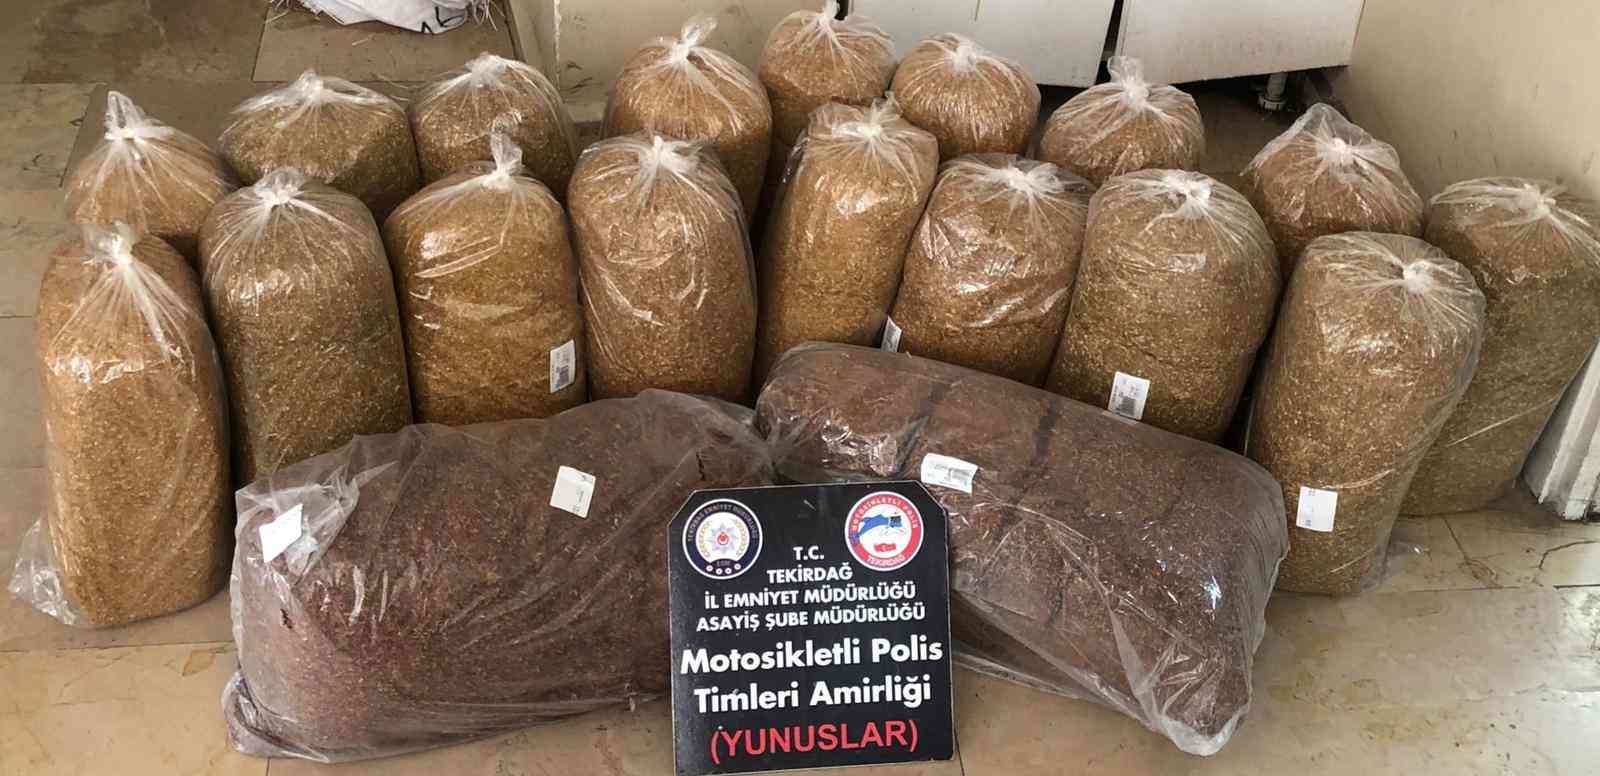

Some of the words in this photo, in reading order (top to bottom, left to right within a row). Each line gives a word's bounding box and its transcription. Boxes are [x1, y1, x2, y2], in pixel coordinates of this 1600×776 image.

[793, 546, 825, 561] T.C.
[767, 562, 853, 584] TEKİRDAĞ
[704, 591, 719, 609] İL
[724, 587, 799, 608] EMNİYET
[804, 581, 916, 604] MÜDÜRLÜĞÜ
[696, 613, 760, 632] ASAYİŞ
[765, 609, 808, 631] ŞUBE
[813, 602, 926, 626] MÜDÜRLÜĞÜ
[680, 637, 861, 674] Motosikletli
[871, 634, 943, 663] Polis
[694, 681, 799, 713] Timleri
[809, 674, 931, 708] Amirliği
[711, 719, 918, 764] (YUNUSLAR)
